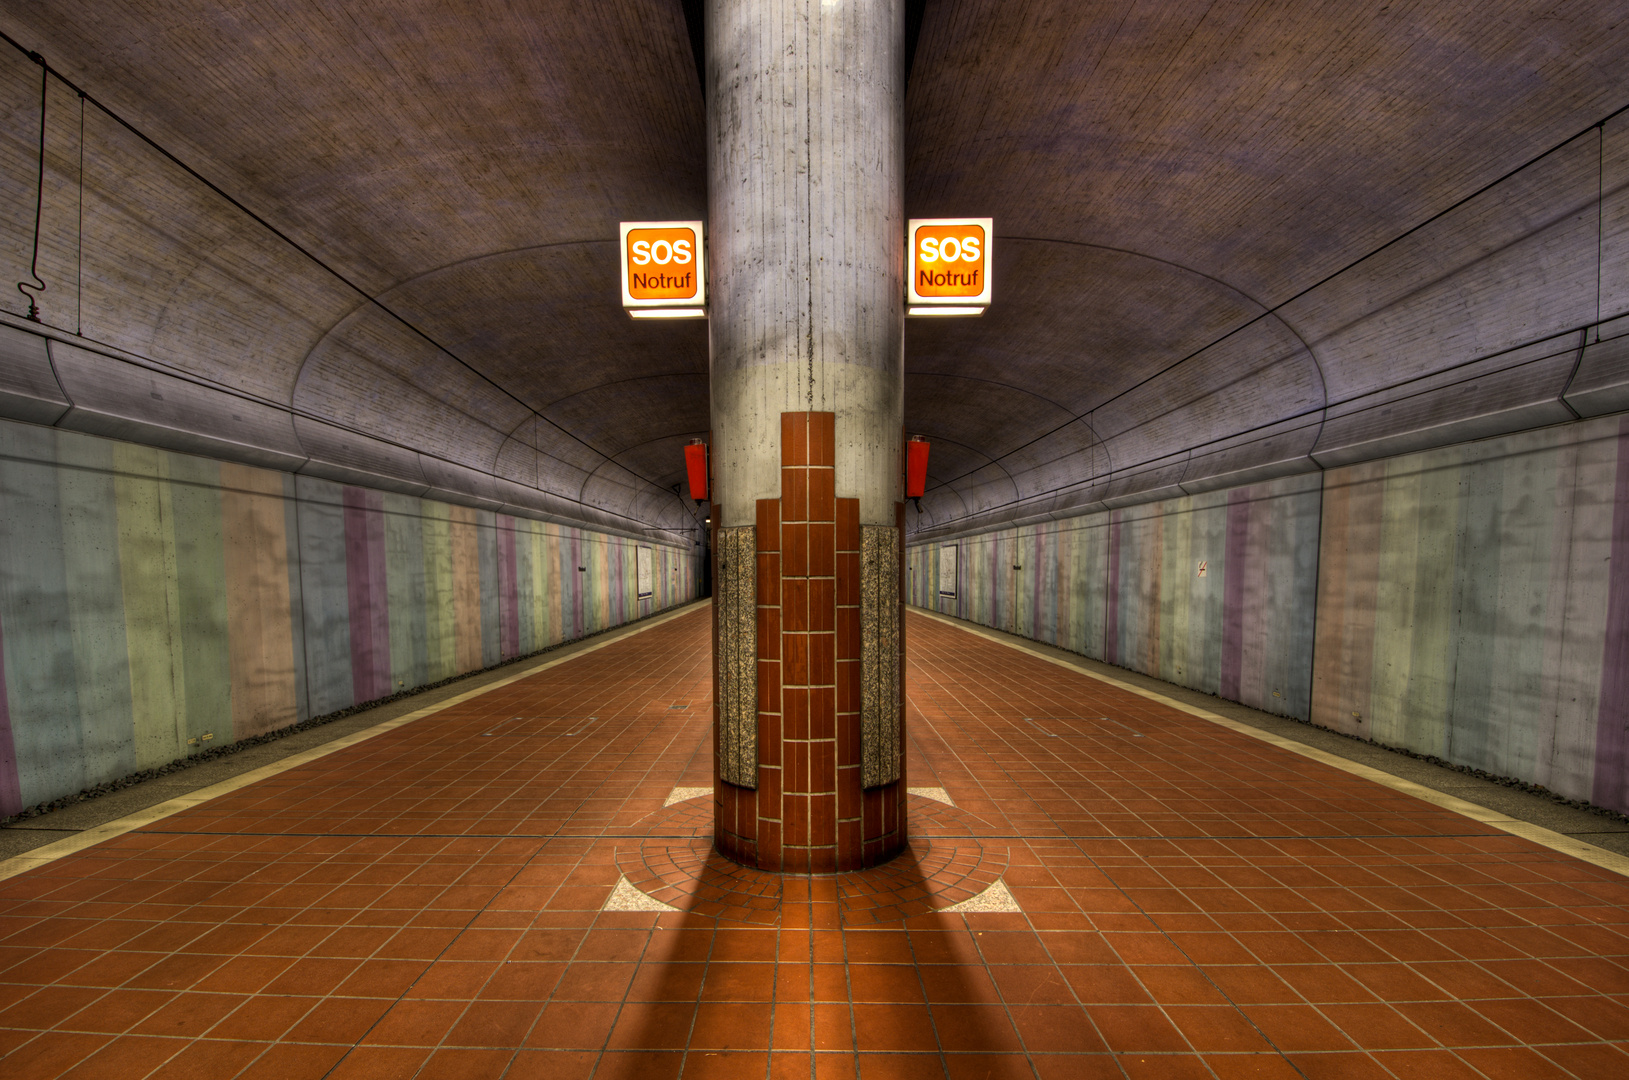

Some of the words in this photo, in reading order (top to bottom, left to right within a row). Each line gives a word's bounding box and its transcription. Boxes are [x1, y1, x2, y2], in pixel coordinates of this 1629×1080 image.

[632, 239, 692, 265] SOS
[919, 236, 981, 263] SOS
[633, 272, 692, 289] Notruf
[919, 270, 979, 287] Notruf
